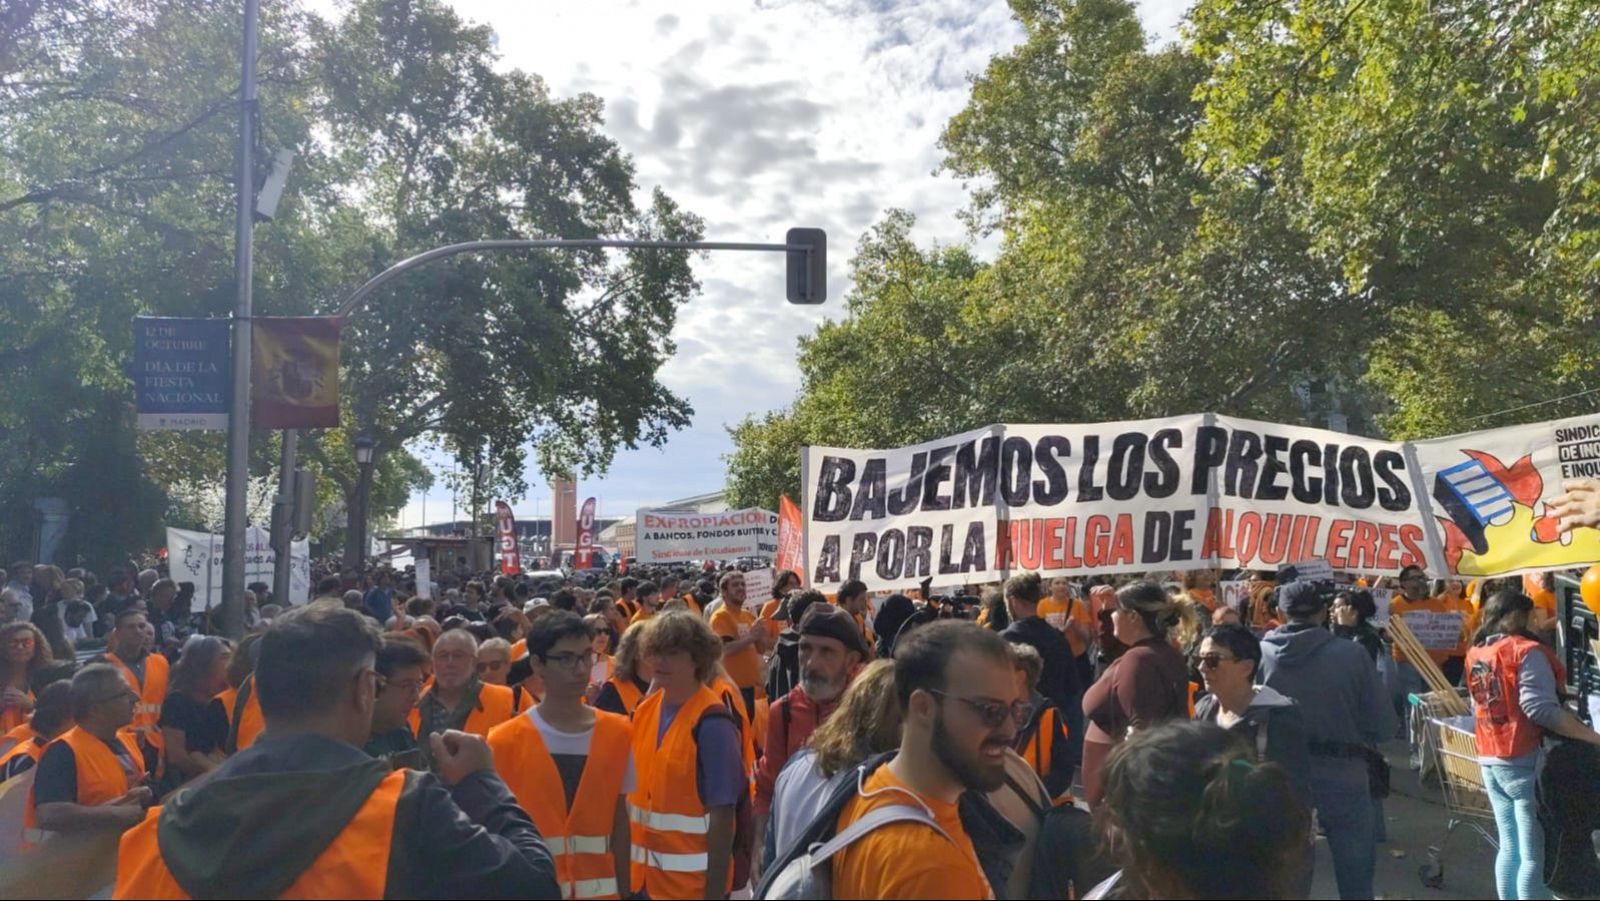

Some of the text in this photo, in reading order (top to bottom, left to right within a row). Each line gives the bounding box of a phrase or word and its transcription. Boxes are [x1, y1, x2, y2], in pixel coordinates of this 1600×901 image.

[145, 327, 176, 337] 12 DE
[145, 340, 207, 350] OCTUBRE
[176, 362, 195, 373] DE
[198, 362, 217, 373] LA
[145, 376, 195, 388] FIESTA
[145, 393, 223, 404] NACIONAL
[170, 418, 207, 427] MADRID
[1555, 425, 1600, 443] SINDIC
[1561, 446, 1578, 461] DE
[812, 426, 1411, 522] BAJEMOS LOS PRECIOS
[1561, 464, 1570, 479] E
[581, 515, 593, 562] UGT
[644, 532, 651, 540] A
[697, 530, 735, 539] FONDOS
[814, 535, 841, 583] A
[848, 525, 933, 582] POR
[938, 521, 987, 575] LA
[994, 513, 1134, 570] HUELGA
[1141, 509, 1195, 563] DE
[1200, 507, 1428, 570] ALQUILERES
